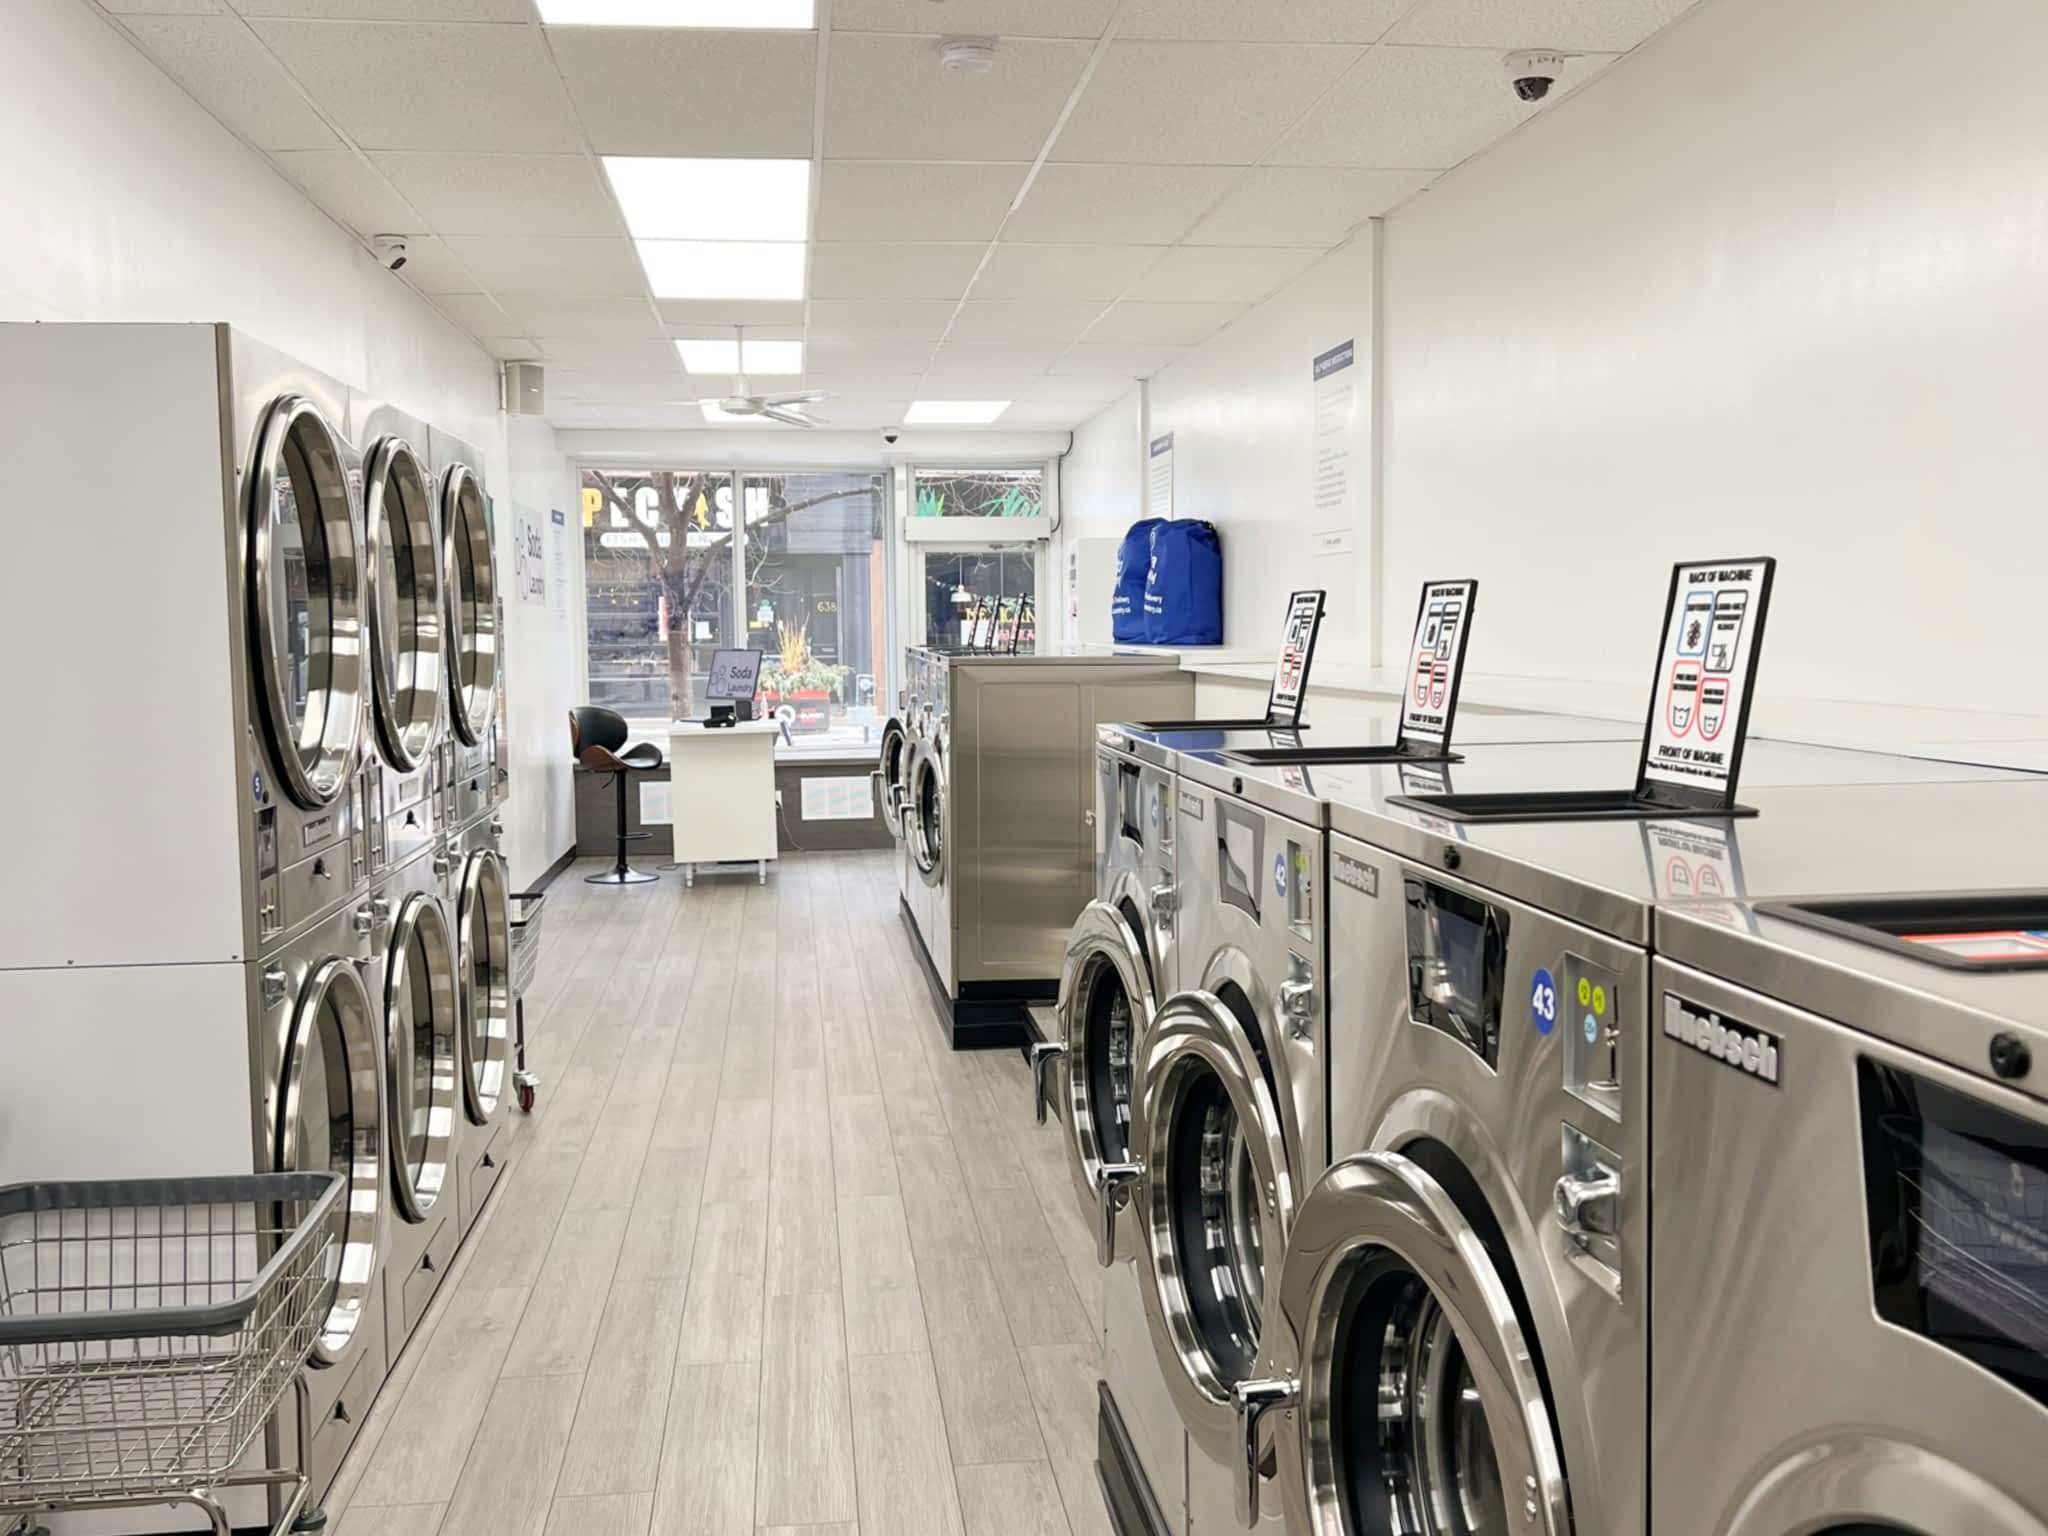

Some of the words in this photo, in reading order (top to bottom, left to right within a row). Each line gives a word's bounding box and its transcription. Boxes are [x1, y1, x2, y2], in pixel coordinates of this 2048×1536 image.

[1689, 572, 1706, 583] BACK
[1707, 571, 1717, 582] OF
[1718, 569, 1752, 581] MACHINE
[730, 666, 752, 679] Soda
[1658, 745, 1682, 757] FRONT
[1682, 748, 1692, 759] OF
[1693, 750, 1723, 765] MACHINE
[1276, 863, 1286, 887] 42
[1533, 983, 1554, 1021] 43
[1664, 994, 1778, 1081] Huebsch
